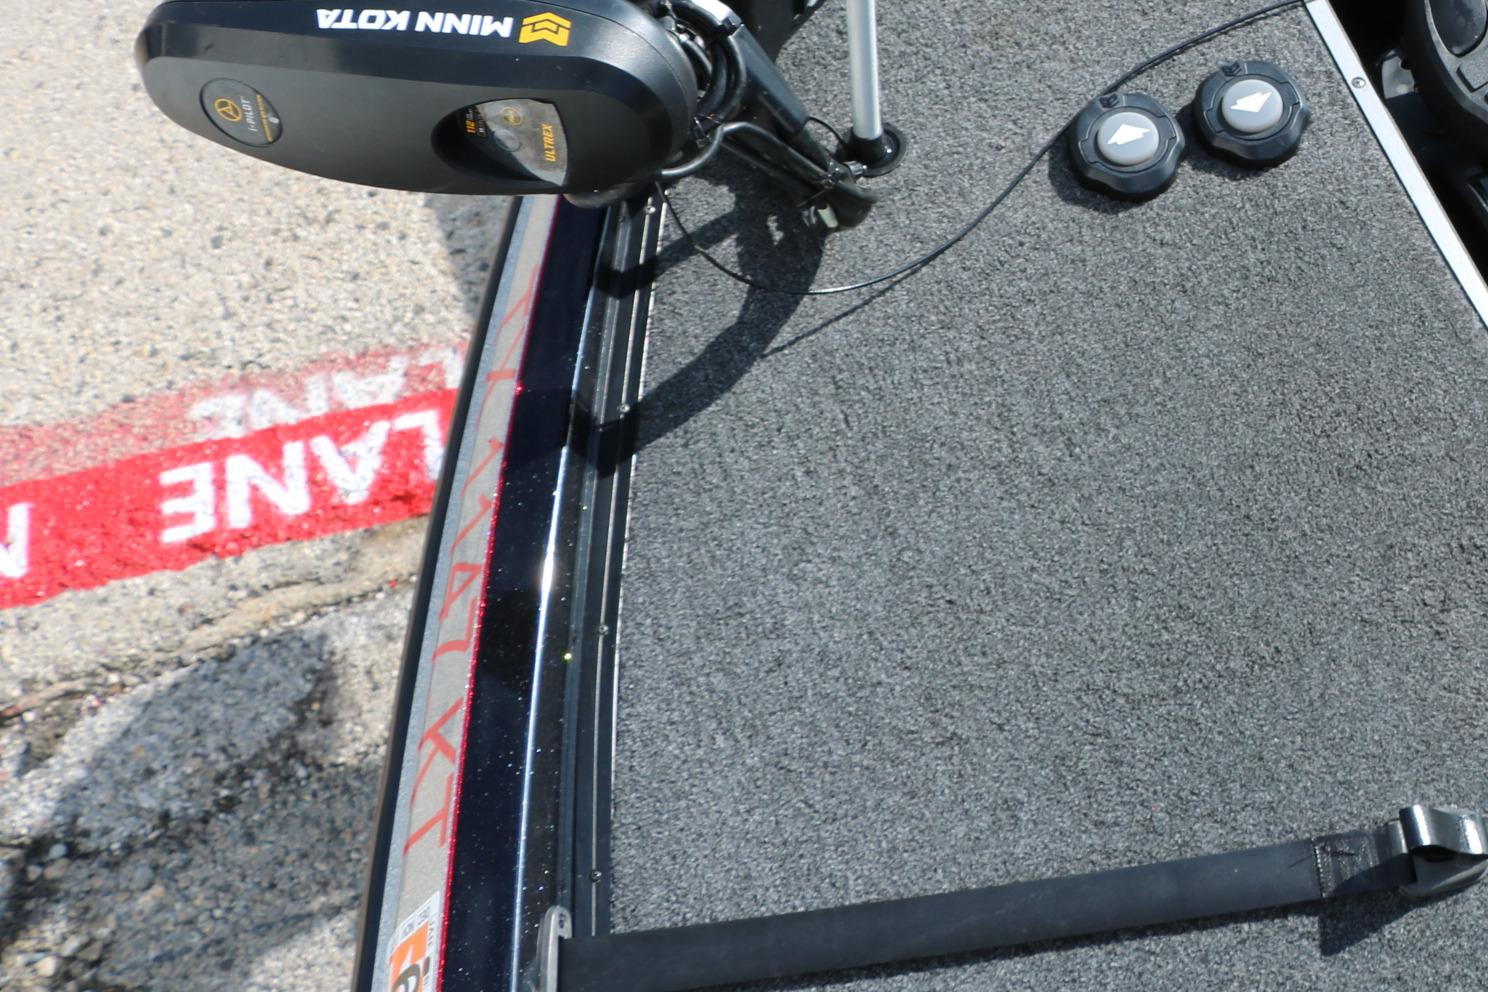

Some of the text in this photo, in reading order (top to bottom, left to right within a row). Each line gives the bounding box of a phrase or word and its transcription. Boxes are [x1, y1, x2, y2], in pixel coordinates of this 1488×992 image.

[316, 8, 514, 38] MINN KOTA
[541, 123, 557, 162] ULTREX
[158, 409, 448, 544] LANE
